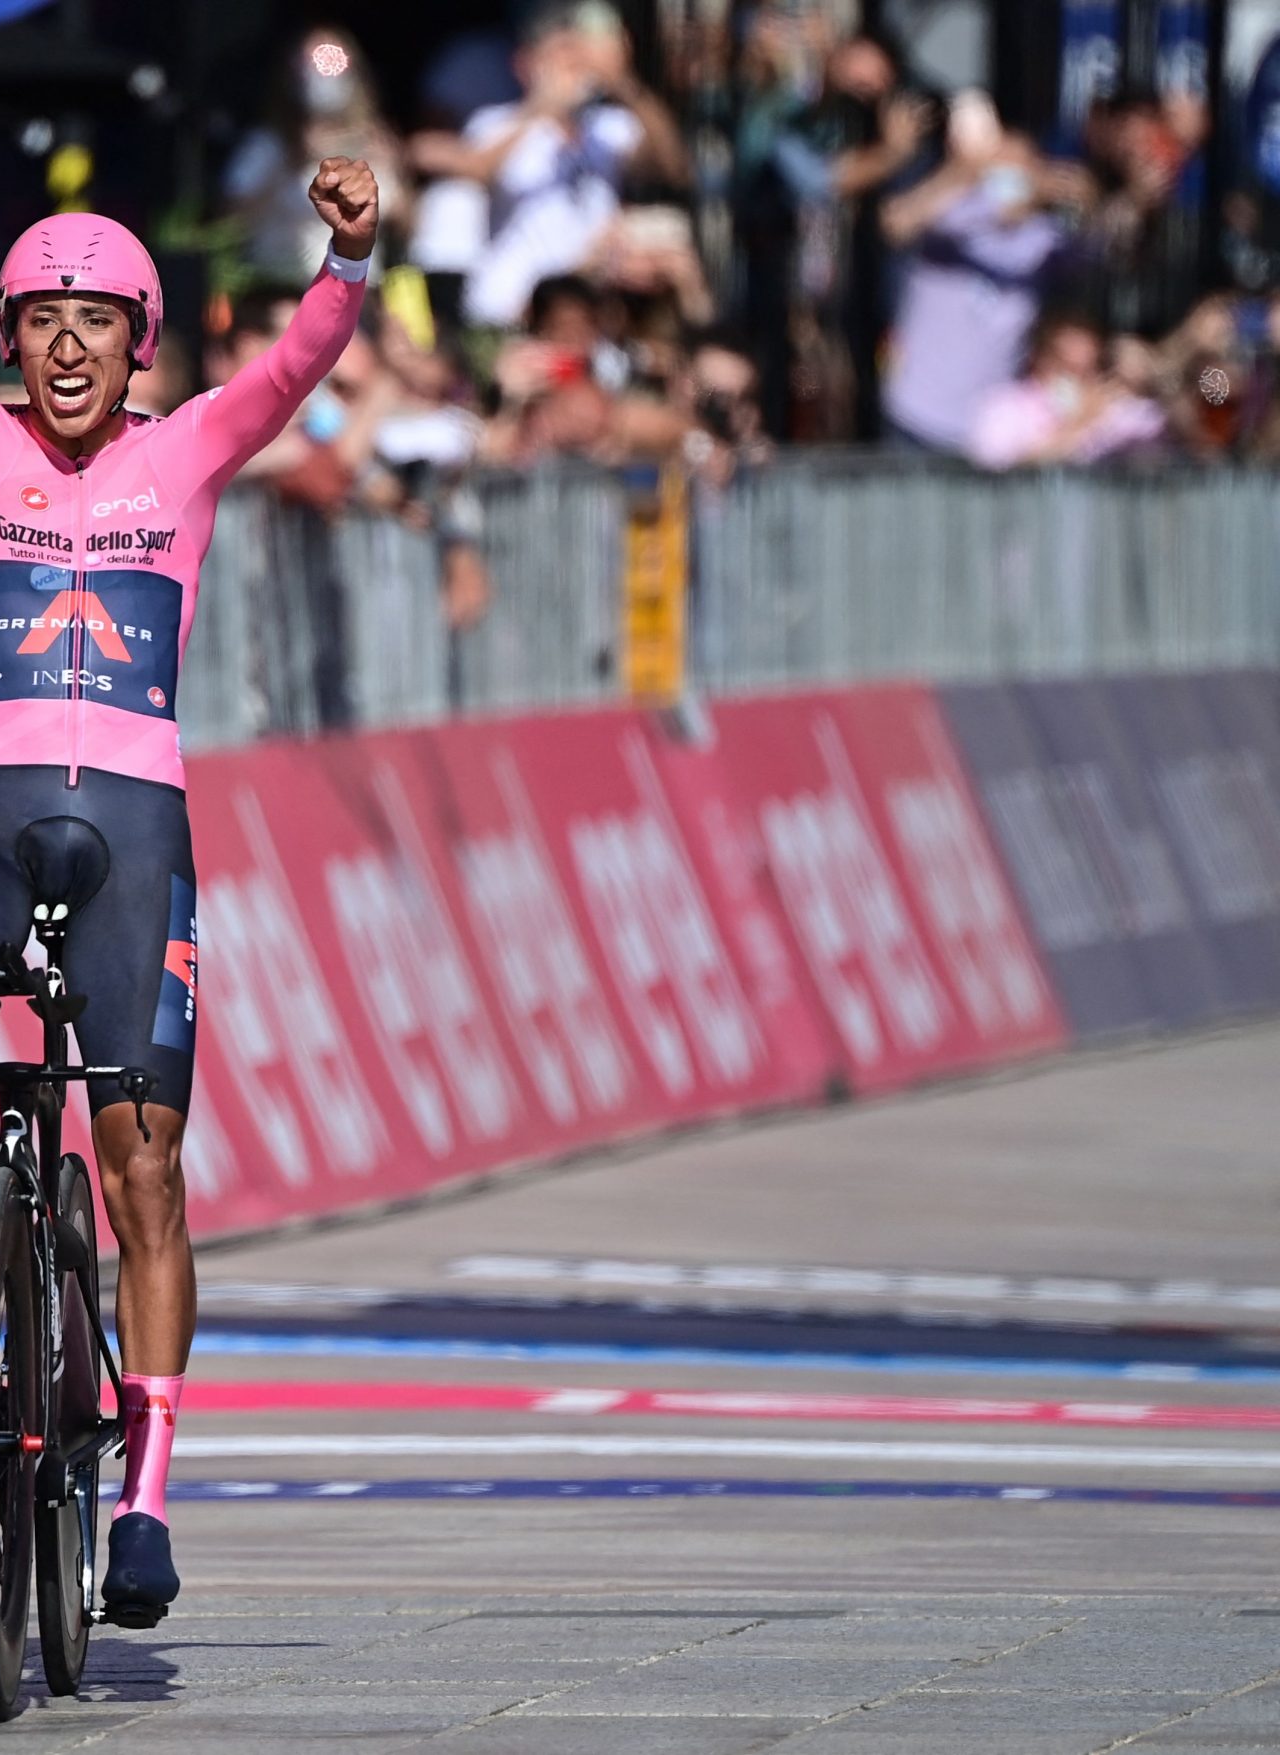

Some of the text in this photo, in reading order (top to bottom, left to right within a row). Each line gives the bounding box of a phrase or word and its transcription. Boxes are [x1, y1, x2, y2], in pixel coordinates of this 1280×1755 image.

[92, 487, 160, 517] enel
[86, 530, 133, 552] dello
[135, 528, 176, 553] Sport
[8, 547, 154, 566] Tutto il rosa della vita
[31, 669, 113, 692] INEOS
